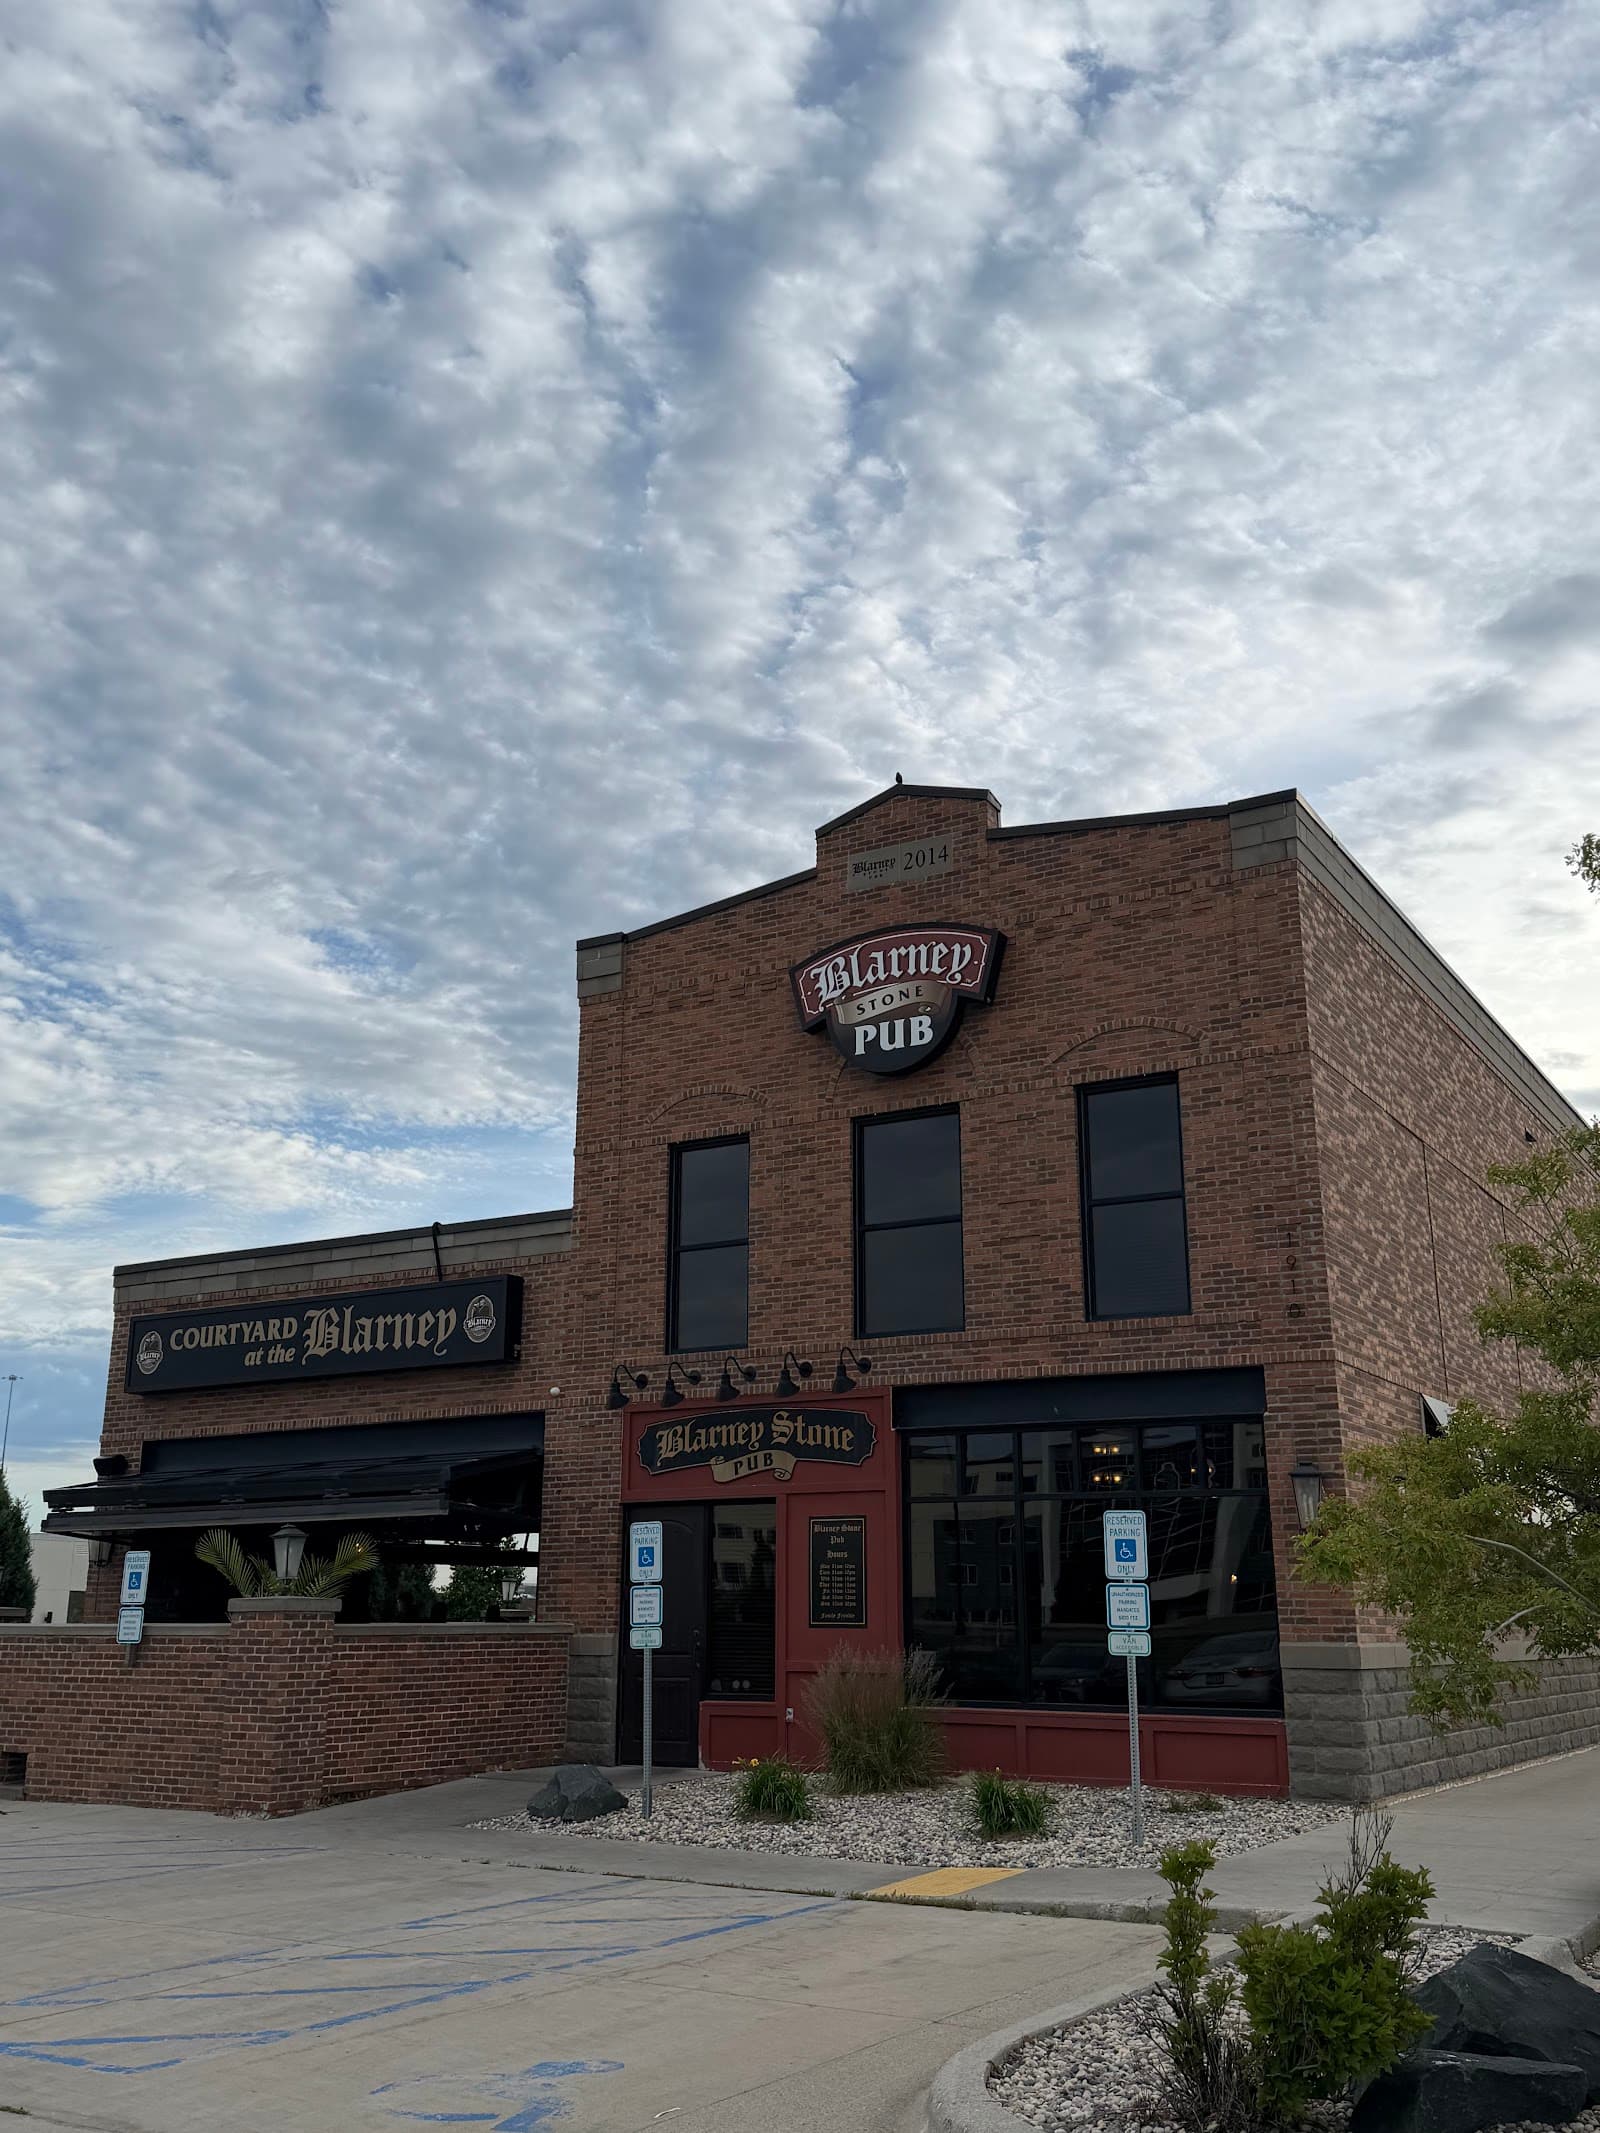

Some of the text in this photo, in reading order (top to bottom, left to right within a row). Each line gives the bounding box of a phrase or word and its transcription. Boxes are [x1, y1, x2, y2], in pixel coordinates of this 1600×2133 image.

[852, 857, 896, 876] Blarney
[903, 844, 949, 871] 2014
[810, 941, 972, 1012] Blarney
[856, 985, 924, 1015] STONE
[854, 1015, 934, 1056] PUB
[170, 1316, 298, 1351] COURTYARD
[301, 1305, 457, 1366] Blarney
[244, 1343, 295, 1367] at the
[656, 1411, 855, 1466] Blarney Stone
[733, 1452, 774, 1476] PUB
[1106, 1516, 1143, 1526] RESERVED
[1109, 1528, 1141, 1537] PARKING
[634, 1536, 658, 1545] PARKING
[1116, 1565, 1136, 1575] ONLY
[1122, 1637, 1137, 1645] VAN
